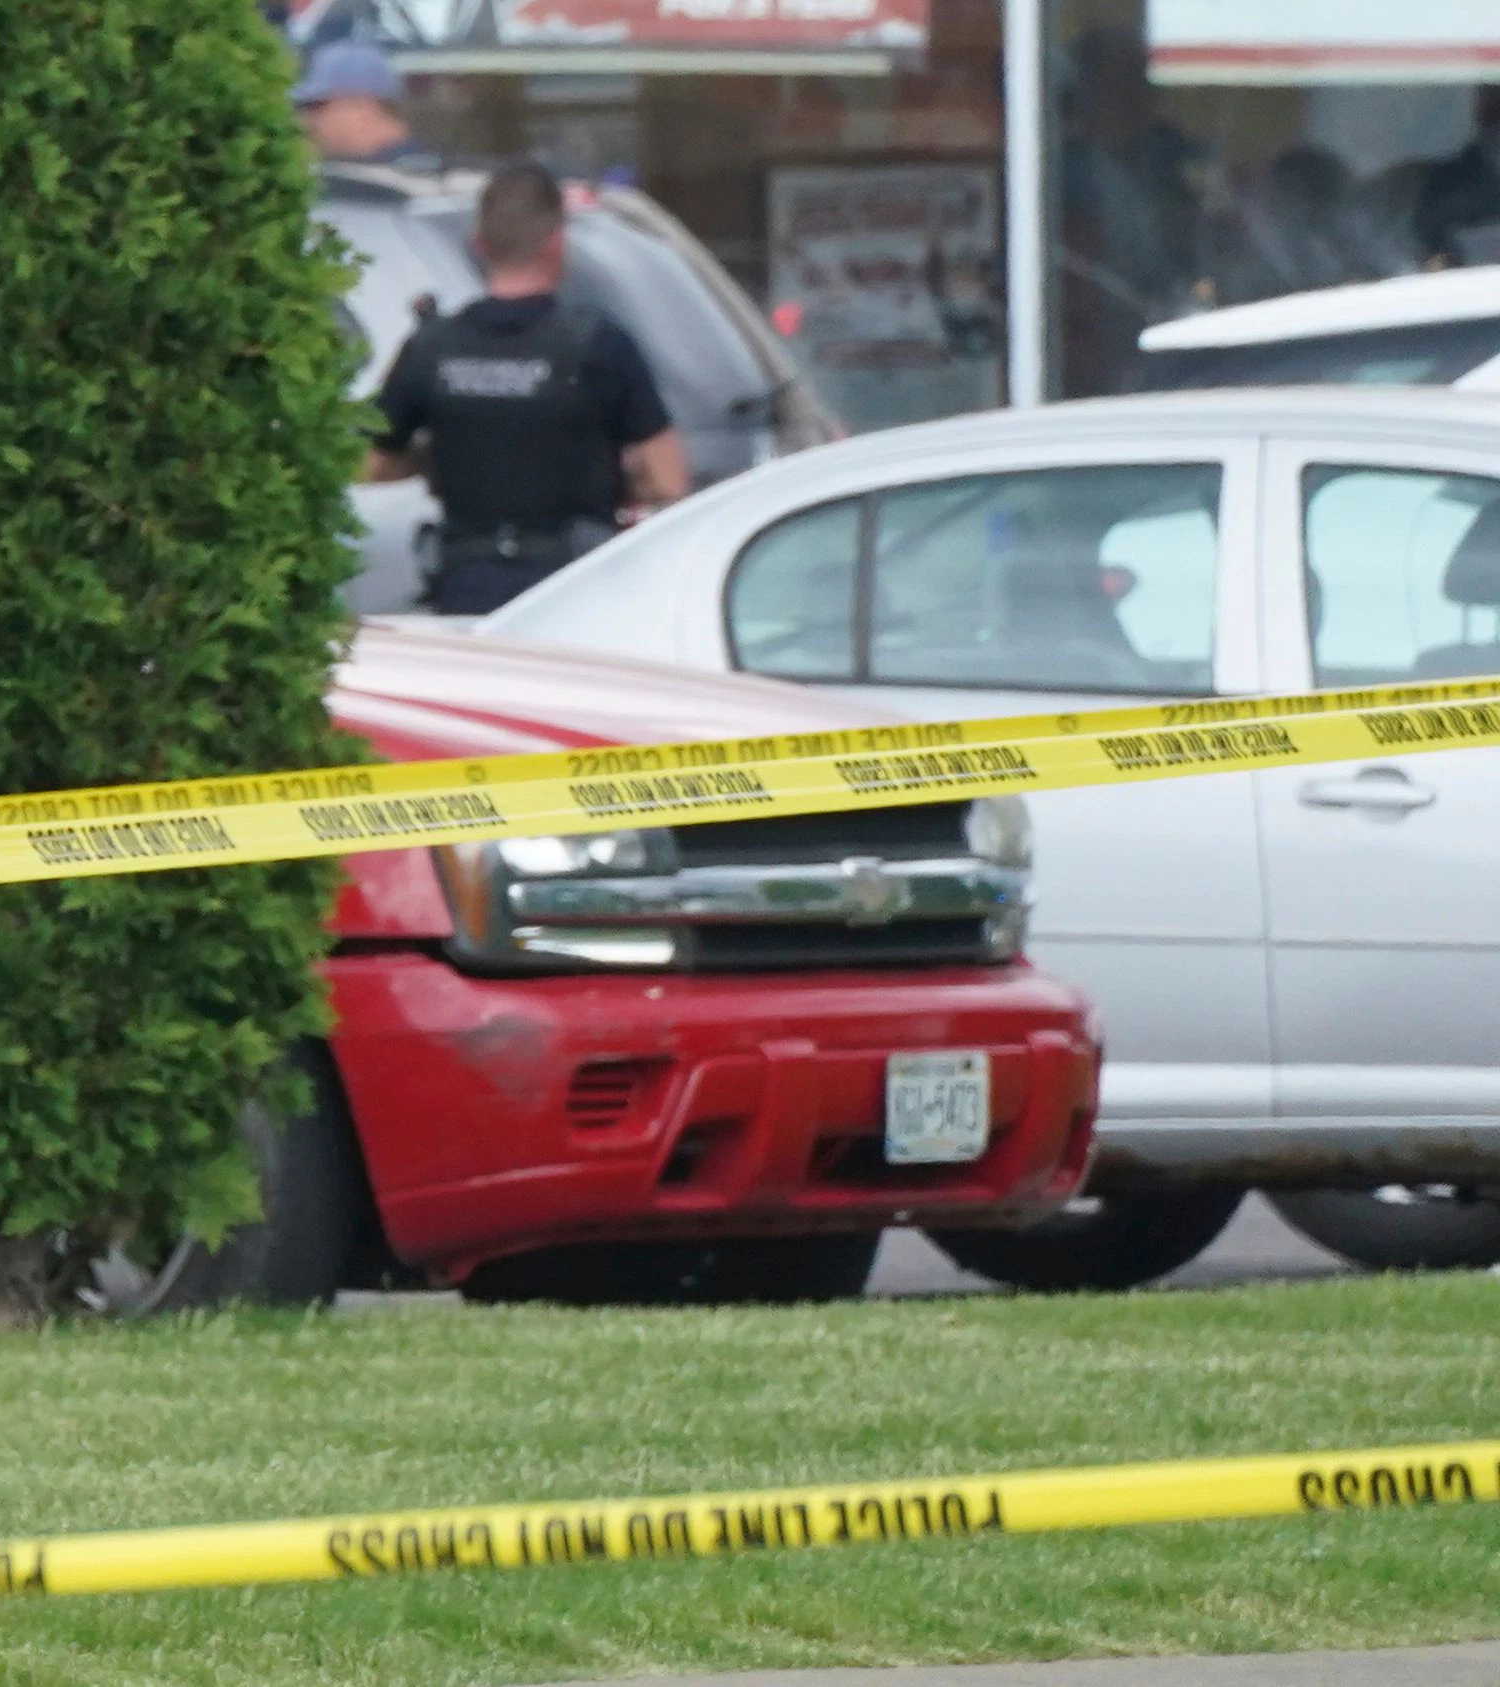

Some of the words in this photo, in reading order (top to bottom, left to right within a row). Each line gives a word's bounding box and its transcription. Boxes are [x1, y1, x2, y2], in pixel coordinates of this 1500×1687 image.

[1298, 1463, 1474, 1510] CROSS
[518, 1516, 605, 1564] NOT
[627, 1510, 691, 1558] DO
[711, 1503, 810, 1550] LINE
[829, 1491, 1003, 1541] POLICE
[328, 1523, 496, 1573] CROSS
